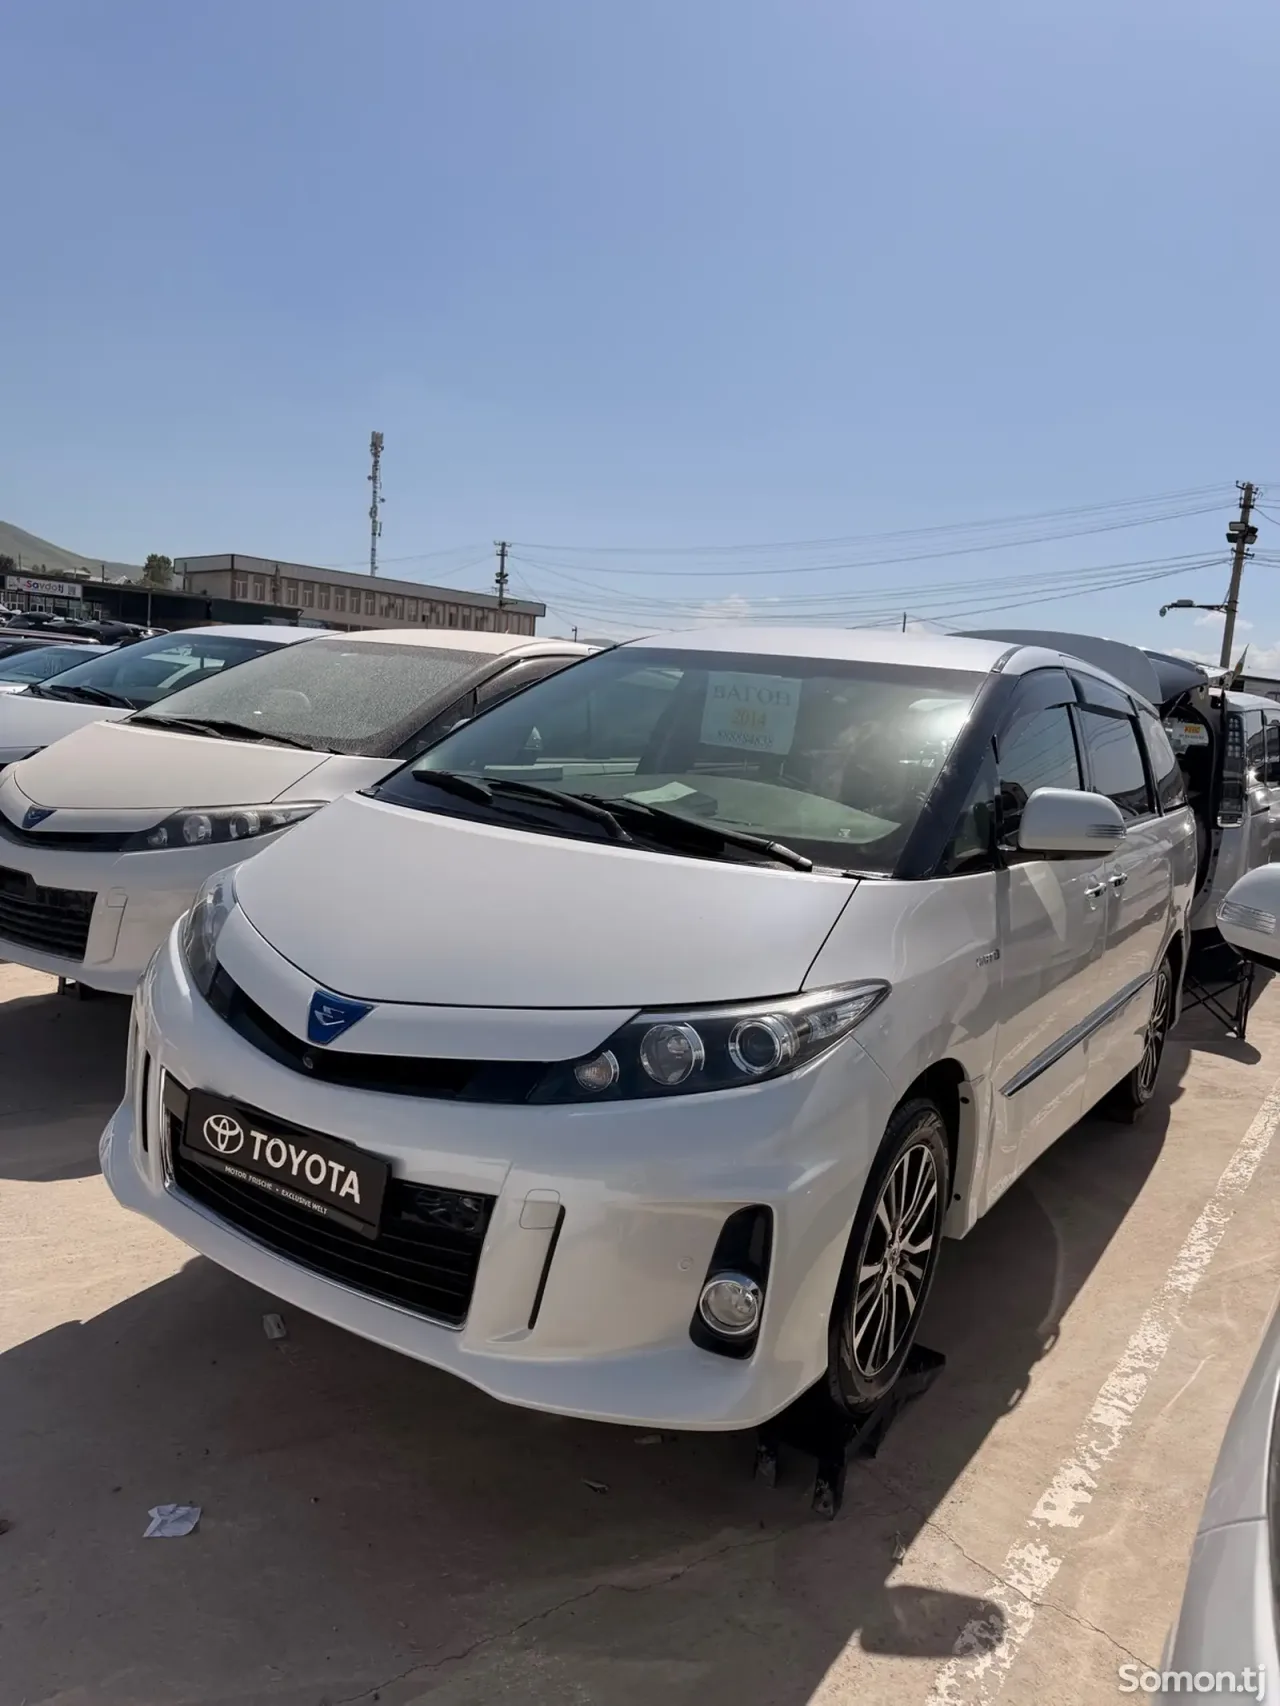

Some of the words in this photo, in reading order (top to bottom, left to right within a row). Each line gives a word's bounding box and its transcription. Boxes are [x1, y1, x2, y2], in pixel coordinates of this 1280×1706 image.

[224, 1165, 247, 1180] MOTOR
[311, 1202, 328, 1215] WELT
[250, 1130, 361, 1204] TOYOTA
